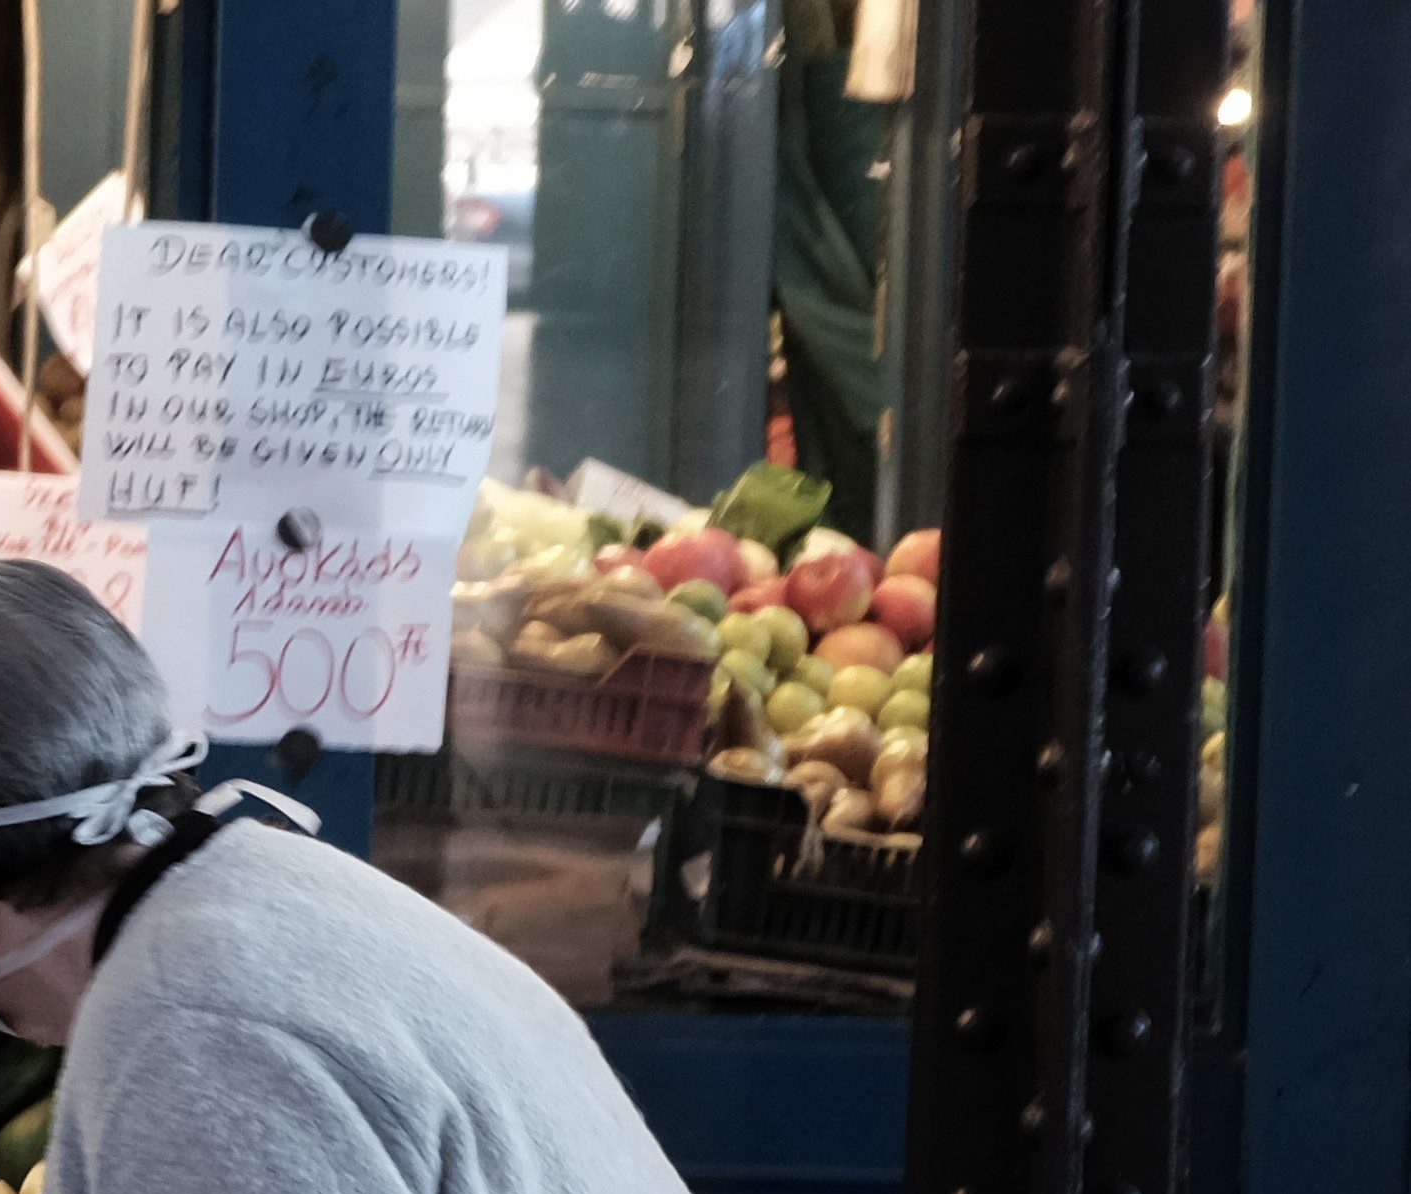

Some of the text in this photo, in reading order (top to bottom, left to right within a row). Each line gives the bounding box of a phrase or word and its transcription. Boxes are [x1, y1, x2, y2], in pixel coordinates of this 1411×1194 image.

[149, 234, 490, 296] DEAR CUSTOMERS!
[112, 303, 481, 351] IT IS ALSO POSSIBLE
[105, 353, 439, 391] TO PAY IN EUROS
[107, 391, 148, 421] IN
[163, 395, 233, 425] OUR
[347, 400, 394, 434] THE
[410, 405, 496, 440] RETURN
[104, 430, 456, 474] WILL BE GIVEN ONLY
[202, 619, 431, 727] 500 Ft
